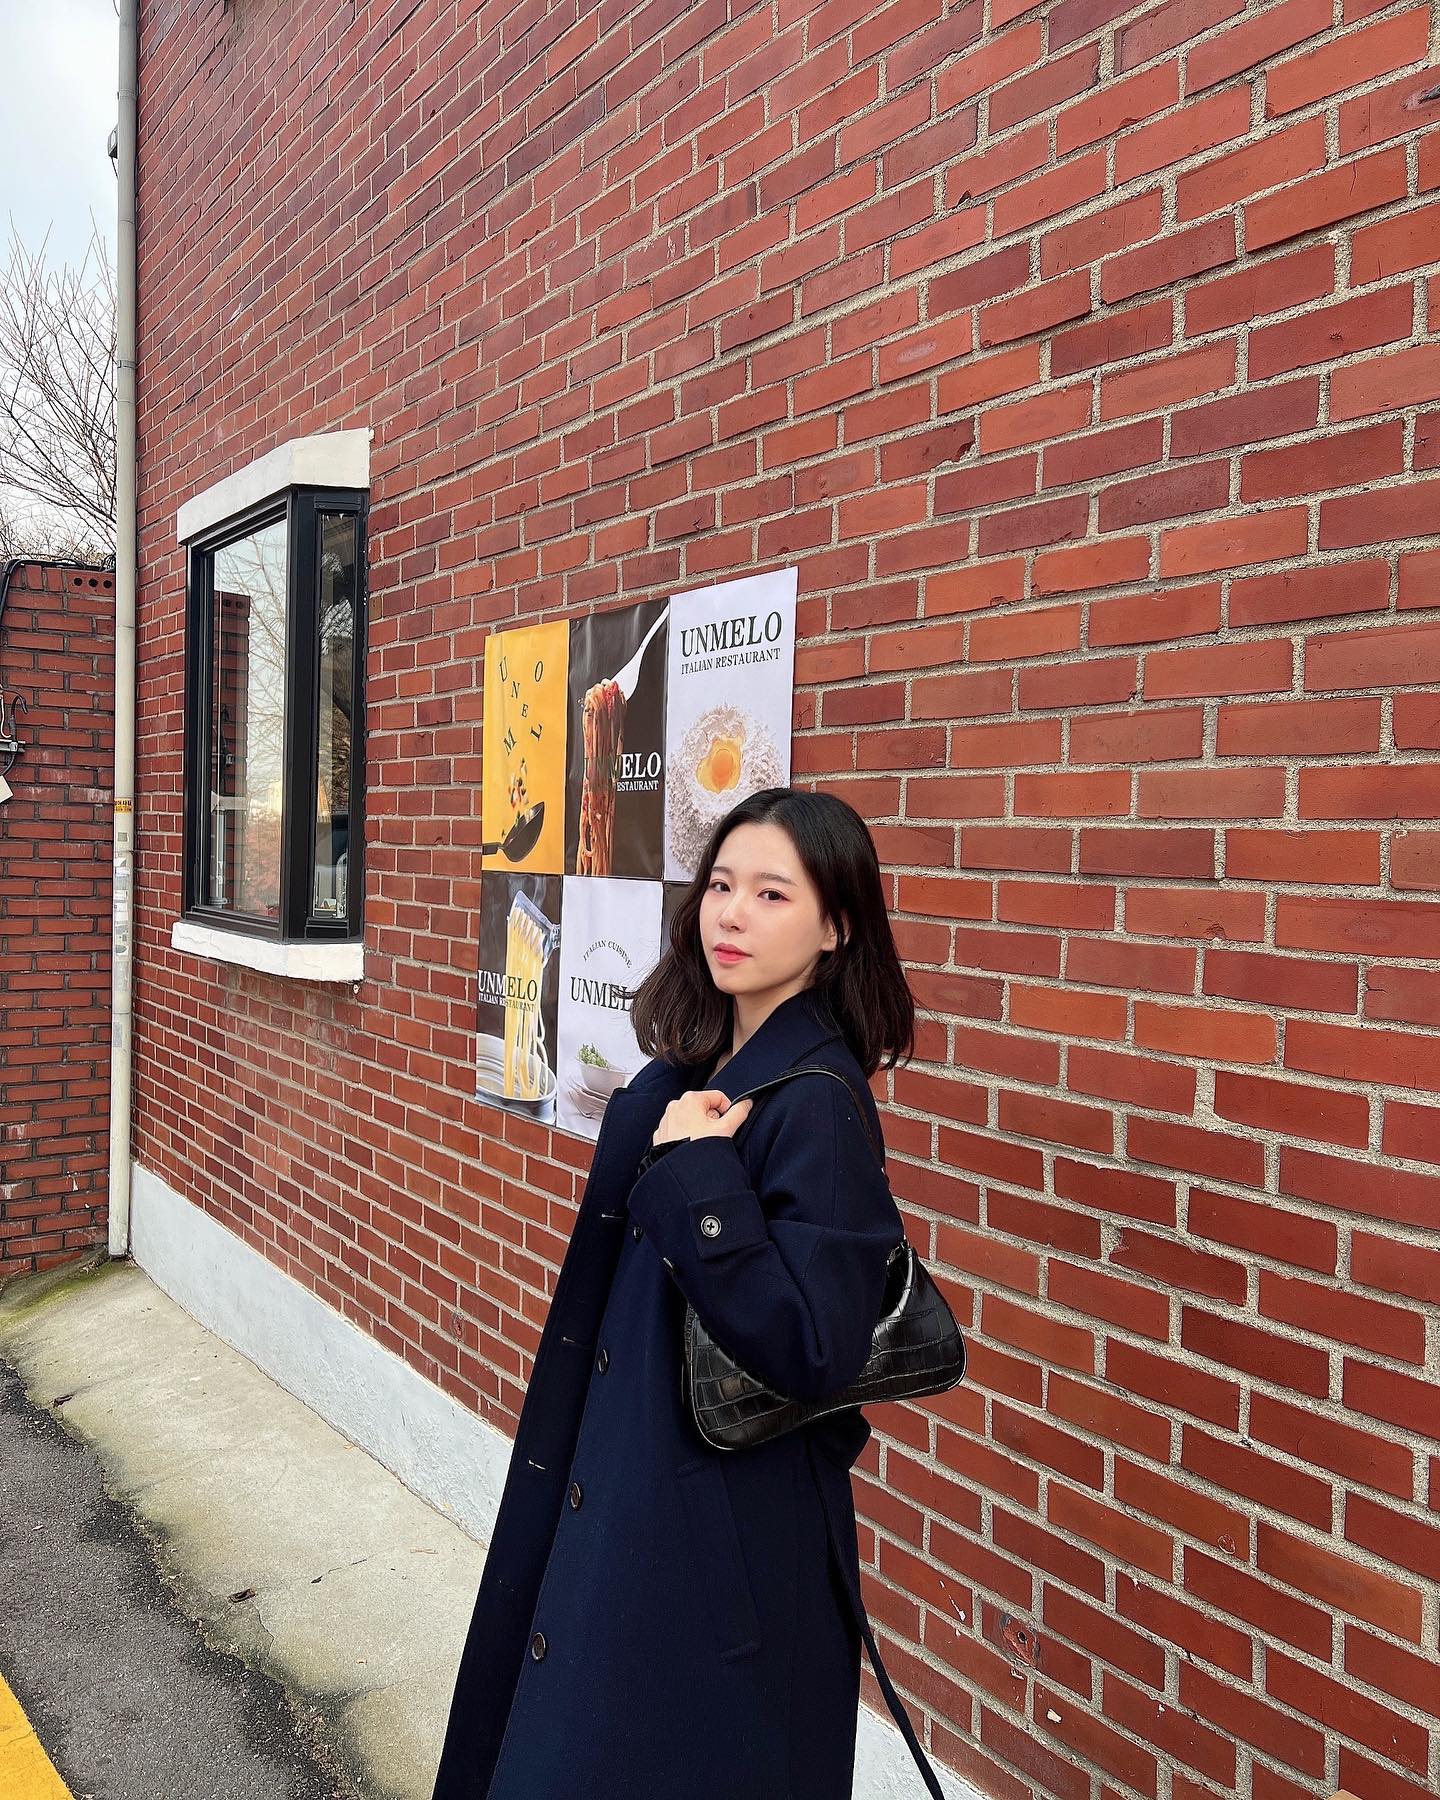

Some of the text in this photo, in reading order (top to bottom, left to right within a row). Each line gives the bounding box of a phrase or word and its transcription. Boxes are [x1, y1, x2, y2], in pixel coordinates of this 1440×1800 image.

[680, 611, 782, 658] UNMELO
[681, 647, 781, 675] ITALIAN RESTAURANT
[616, 780, 659, 792] ESTAURANT
[583, 939, 632, 969] ITALIAN CUISINE
[477, 969, 538, 1002] UNMELO
[570, 976, 632, 1012] UNMEL
[499, 995, 535, 1013] RESTAURANT
